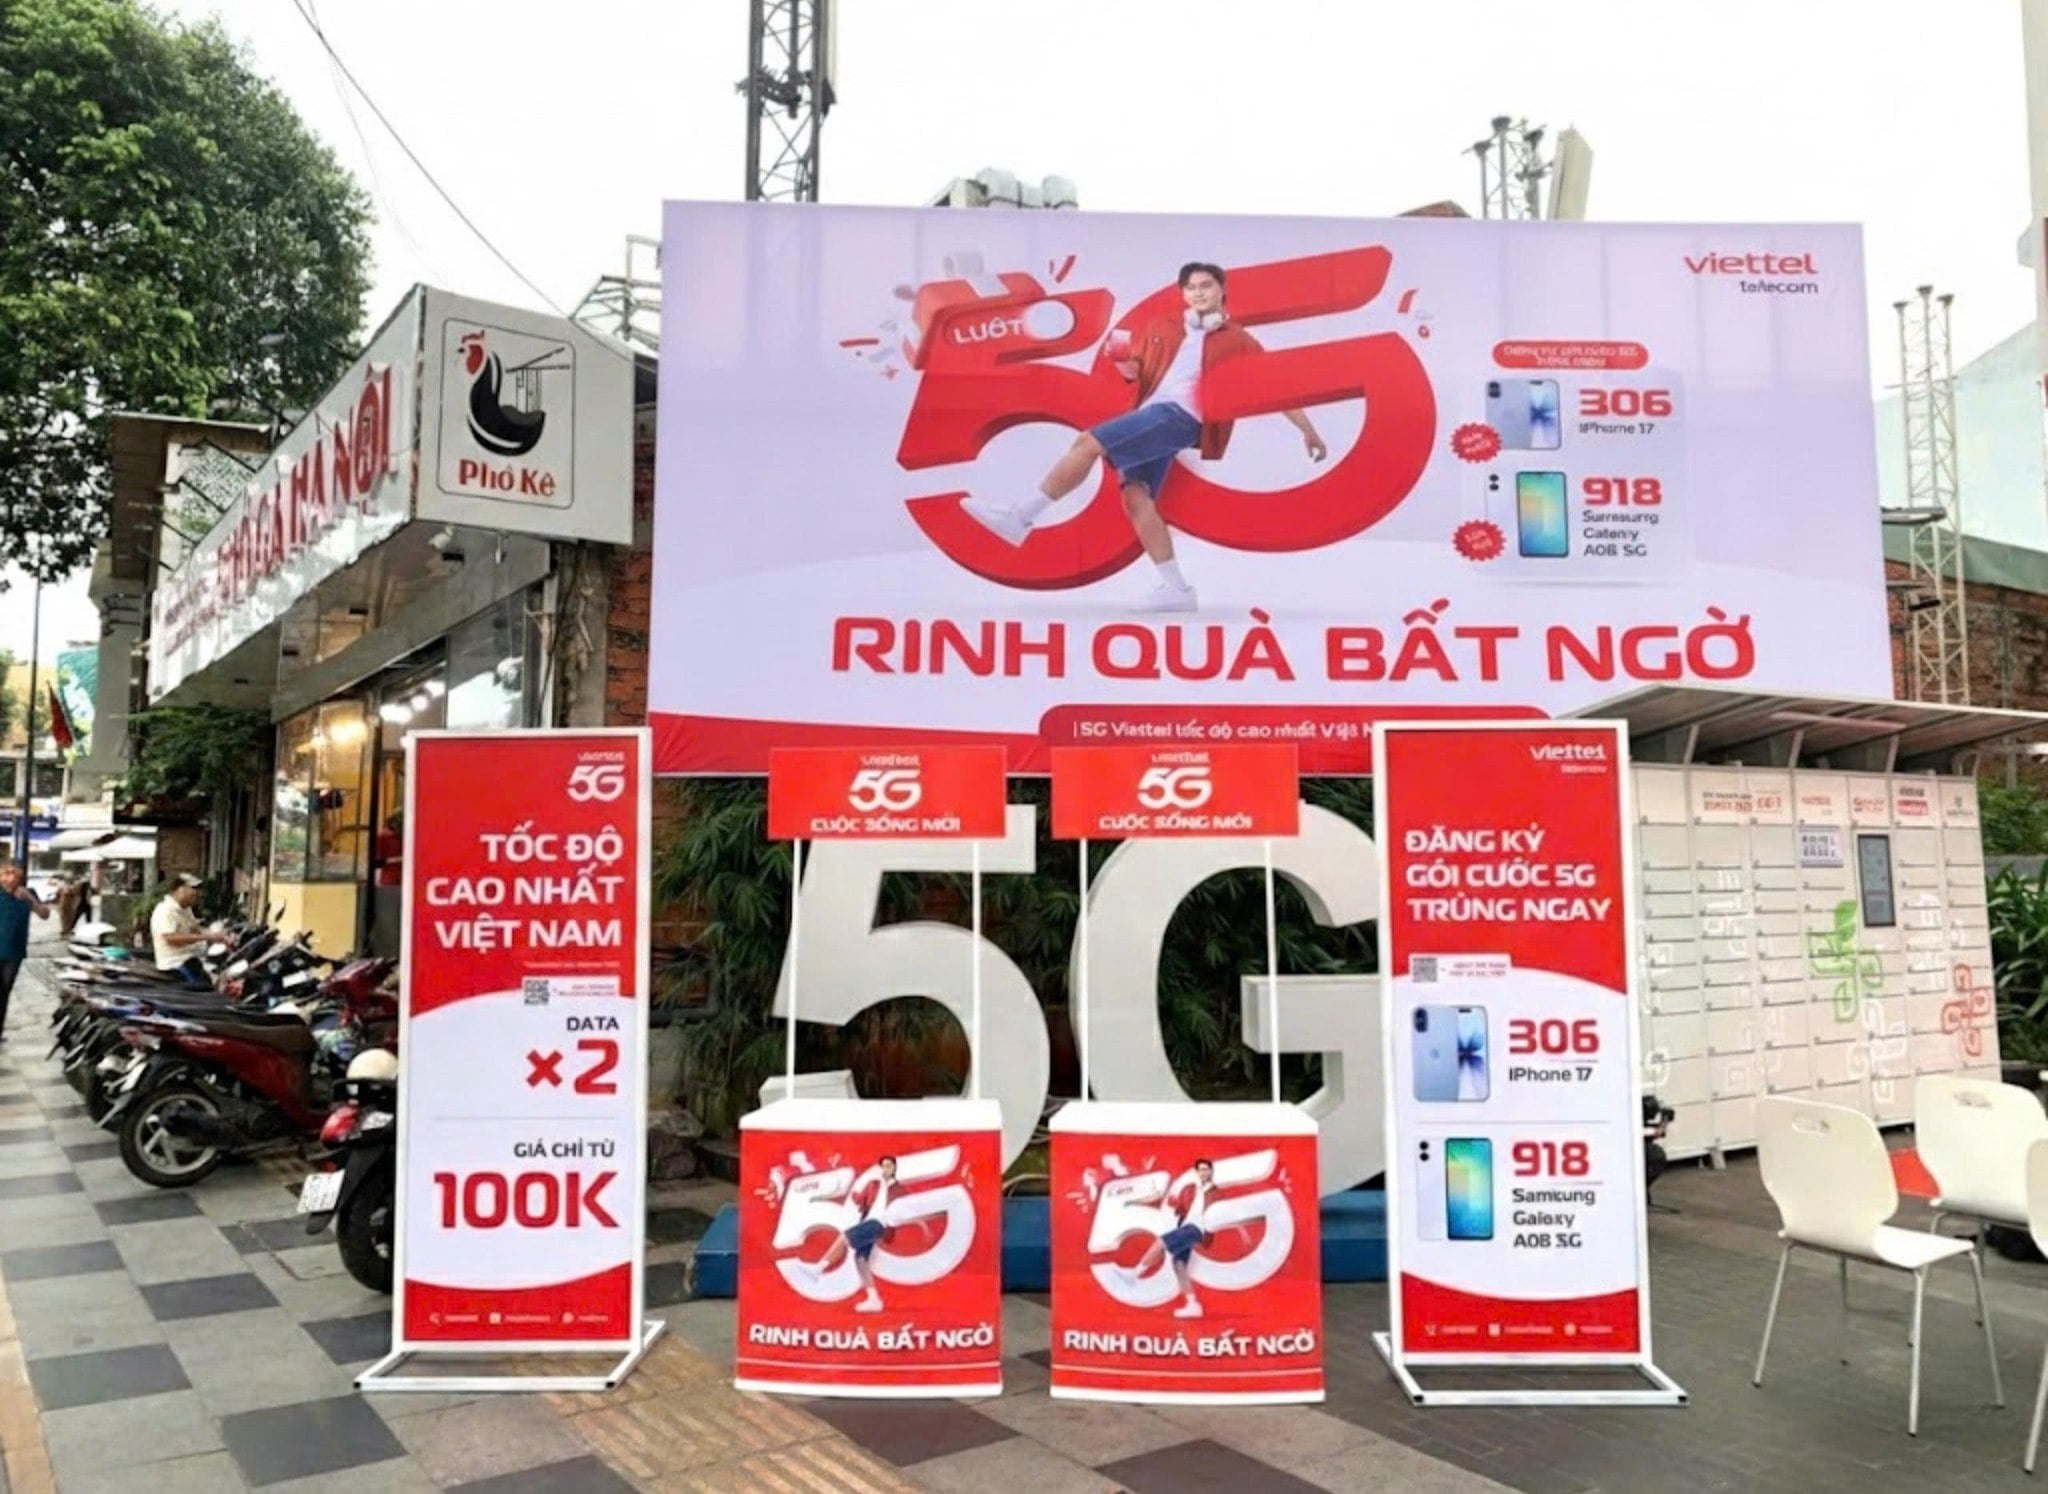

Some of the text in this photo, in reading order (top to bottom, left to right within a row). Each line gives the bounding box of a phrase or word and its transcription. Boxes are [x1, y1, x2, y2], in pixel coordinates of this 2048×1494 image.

[1684, 251, 1819, 275] viettel
[1579, 388, 1673, 417] 306
[1582, 476, 1662, 507] 918
[831, 597, 1756, 682] RINH QUÀ BẤT NGỜ
[1237, 725, 1272, 738] cao
[567, 765, 626, 803] 5G
[848, 768, 923, 812] 5G
[1137, 766, 1213, 810] 5G
[479, 819, 624, 867] TỐC ĐỘ
[1404, 824, 1495, 853] ĐĂNG
[425, 861, 625, 906] CAO NHẤT
[1555, 863, 1596, 887] 5G
[1522, 897, 1612, 921] NGAY
[434, 912, 622, 955] VIỆT NAM
[565, 1016, 620, 1032] DATA
[1508, 1018, 1600, 1054] 306
[1575, 1066, 1594, 1082] 17
[1512, 1141, 1589, 1177] 918
[433, 1170, 621, 1229] 100K
[749, 1323, 810, 1348] RINH
[876, 1323, 931, 1351] BẤT
[1063, 1329, 1128, 1353] RINH
[1197, 1328, 1252, 1357] BẤT
